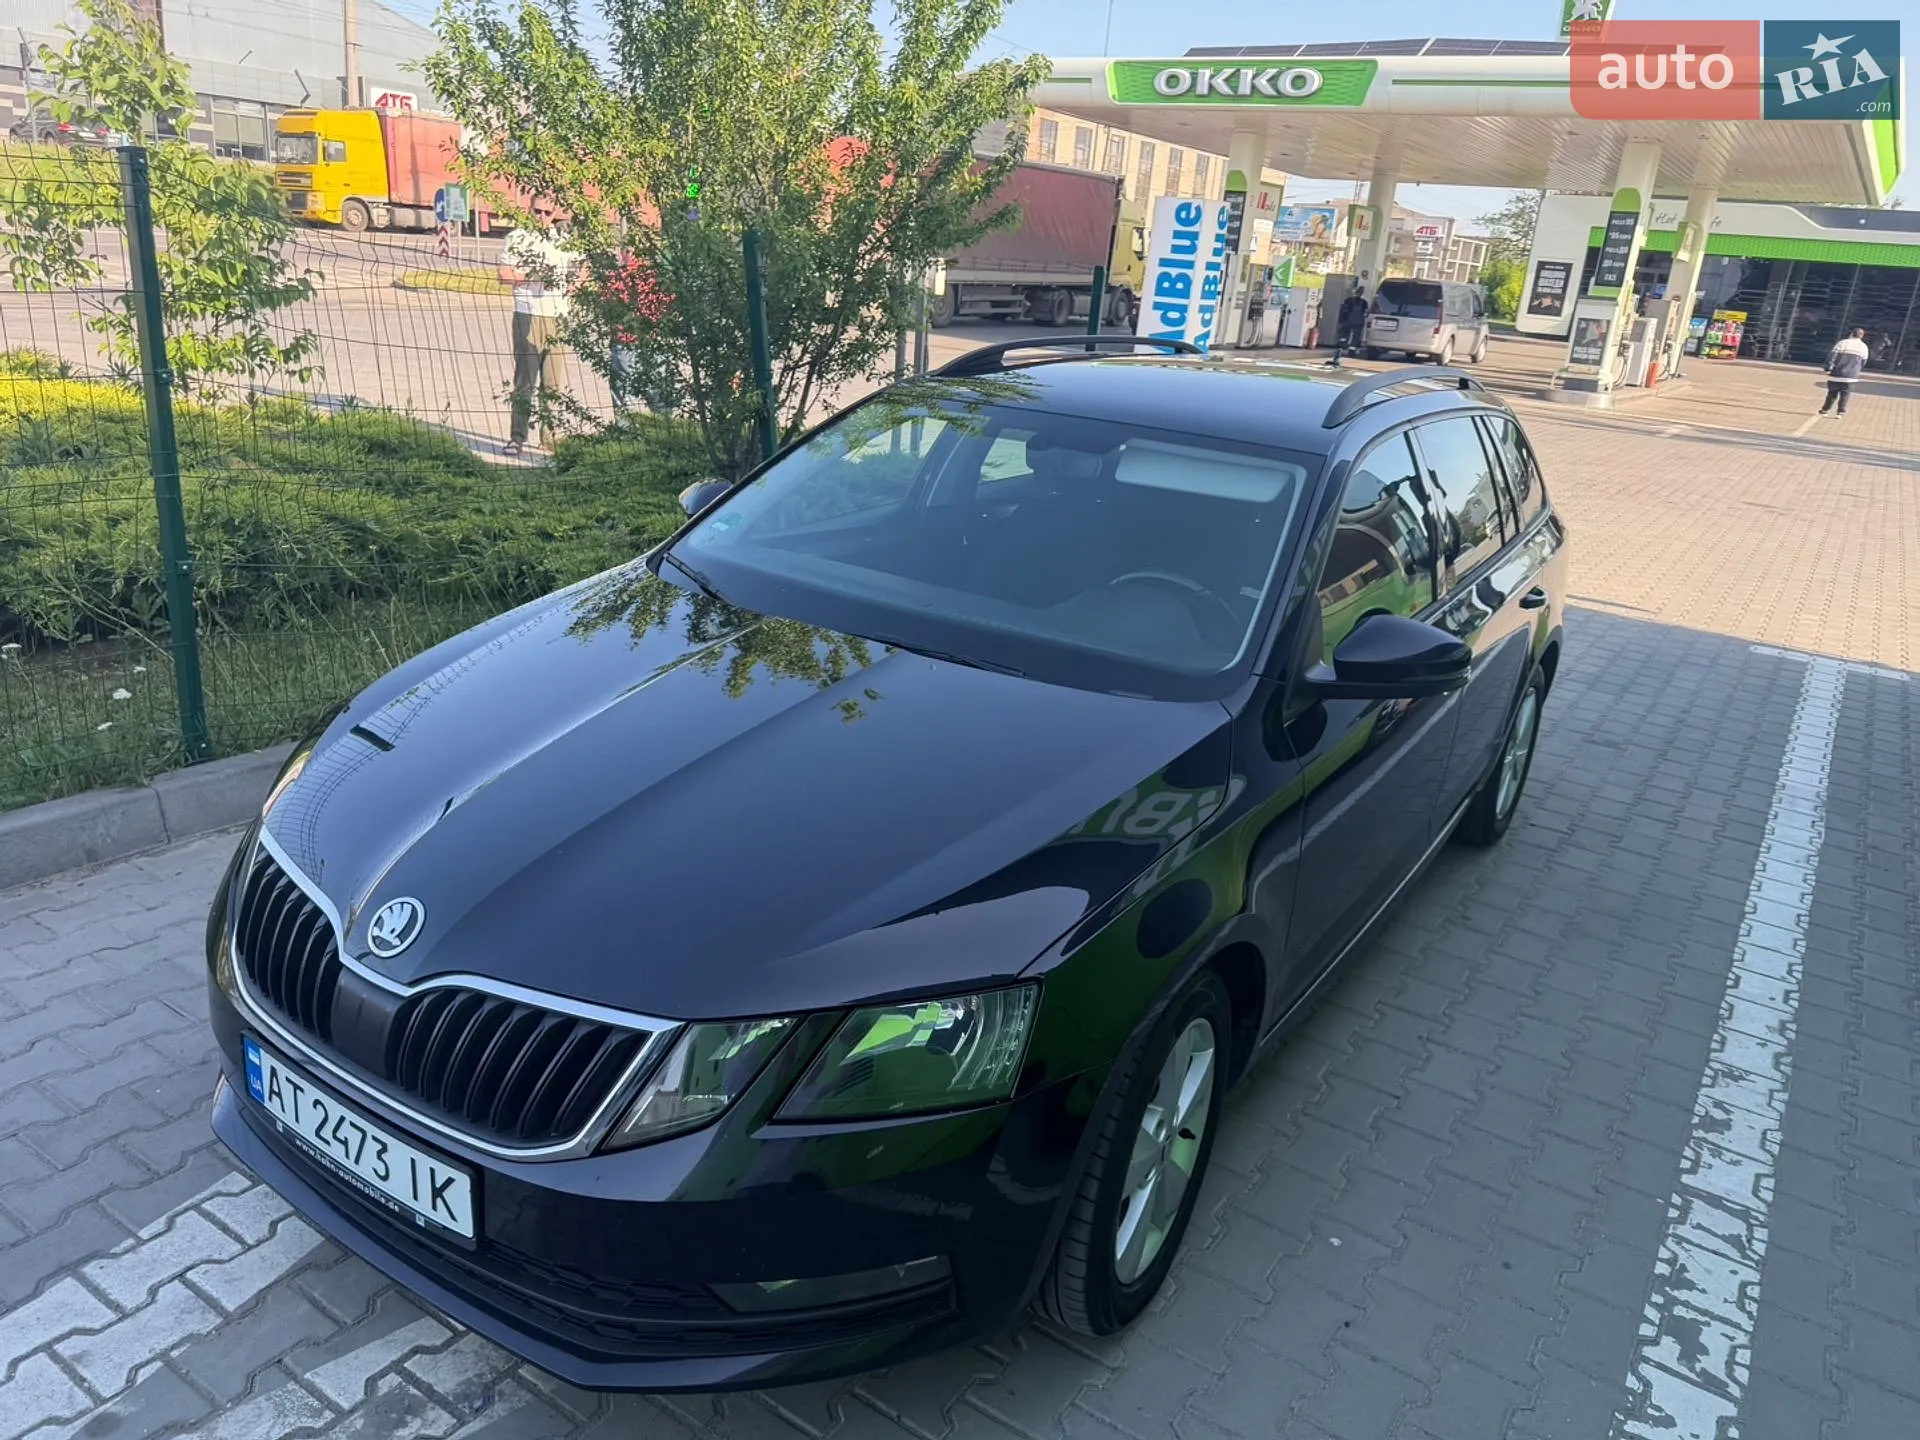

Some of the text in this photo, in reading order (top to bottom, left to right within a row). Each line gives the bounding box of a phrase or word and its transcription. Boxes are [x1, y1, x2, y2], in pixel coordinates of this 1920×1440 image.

[1153, 67, 1324, 98] OKKO
[1149, 201, 1203, 354] AdBlue
[1194, 205, 1229, 354] AdBlue
[250, 1073, 263, 1095] UA
[267, 1064, 458, 1222] AT 2473 IK
